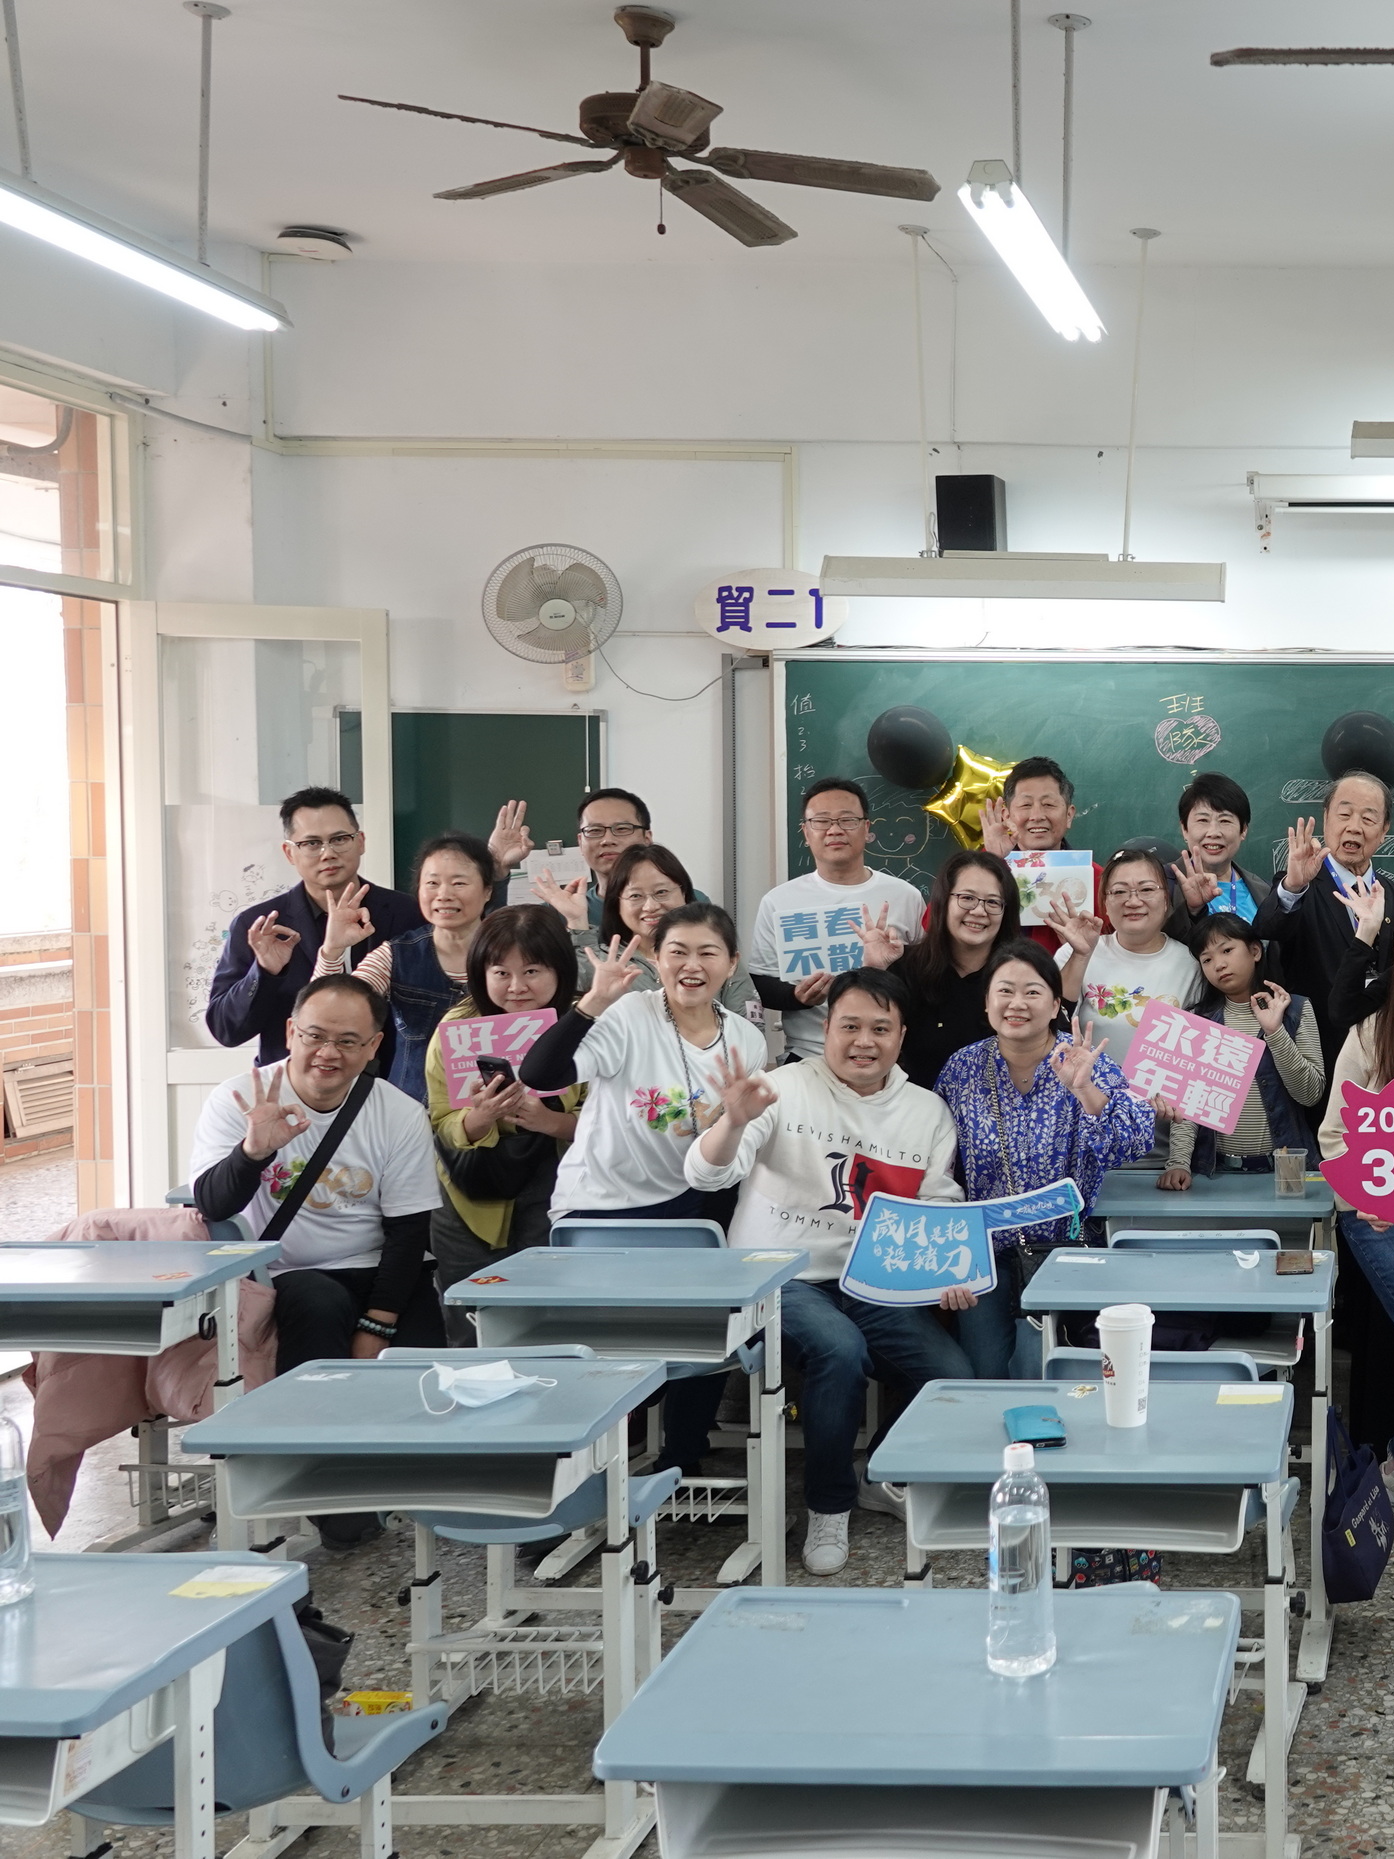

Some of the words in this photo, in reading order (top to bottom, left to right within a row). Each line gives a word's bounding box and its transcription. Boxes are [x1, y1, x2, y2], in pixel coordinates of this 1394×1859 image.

[716, 585, 823, 633] 貿二1
[779, 907, 864, 943] 青春
[783, 941, 865, 977] 不散
[445, 1016, 544, 1059] 好久
[1144, 1011, 1254, 1077] 永遠
[451, 1059, 478, 1070] LON
[1139, 1044, 1196, 1072] FOREVER
[1200, 1066, 1242, 1090] YOUNG
[1129, 1059, 1237, 1129] 年輕
[769, 1205, 835, 1231] TOMMY
[872, 1208, 969, 1247] 歲月是把
[881, 1244, 972, 1280] 殺豬刀
[1367, 1497, 1374, 1507] et
[1369, 1485, 1380, 1500] Lisa
[1351, 1500, 1370, 1529] Gaspard
